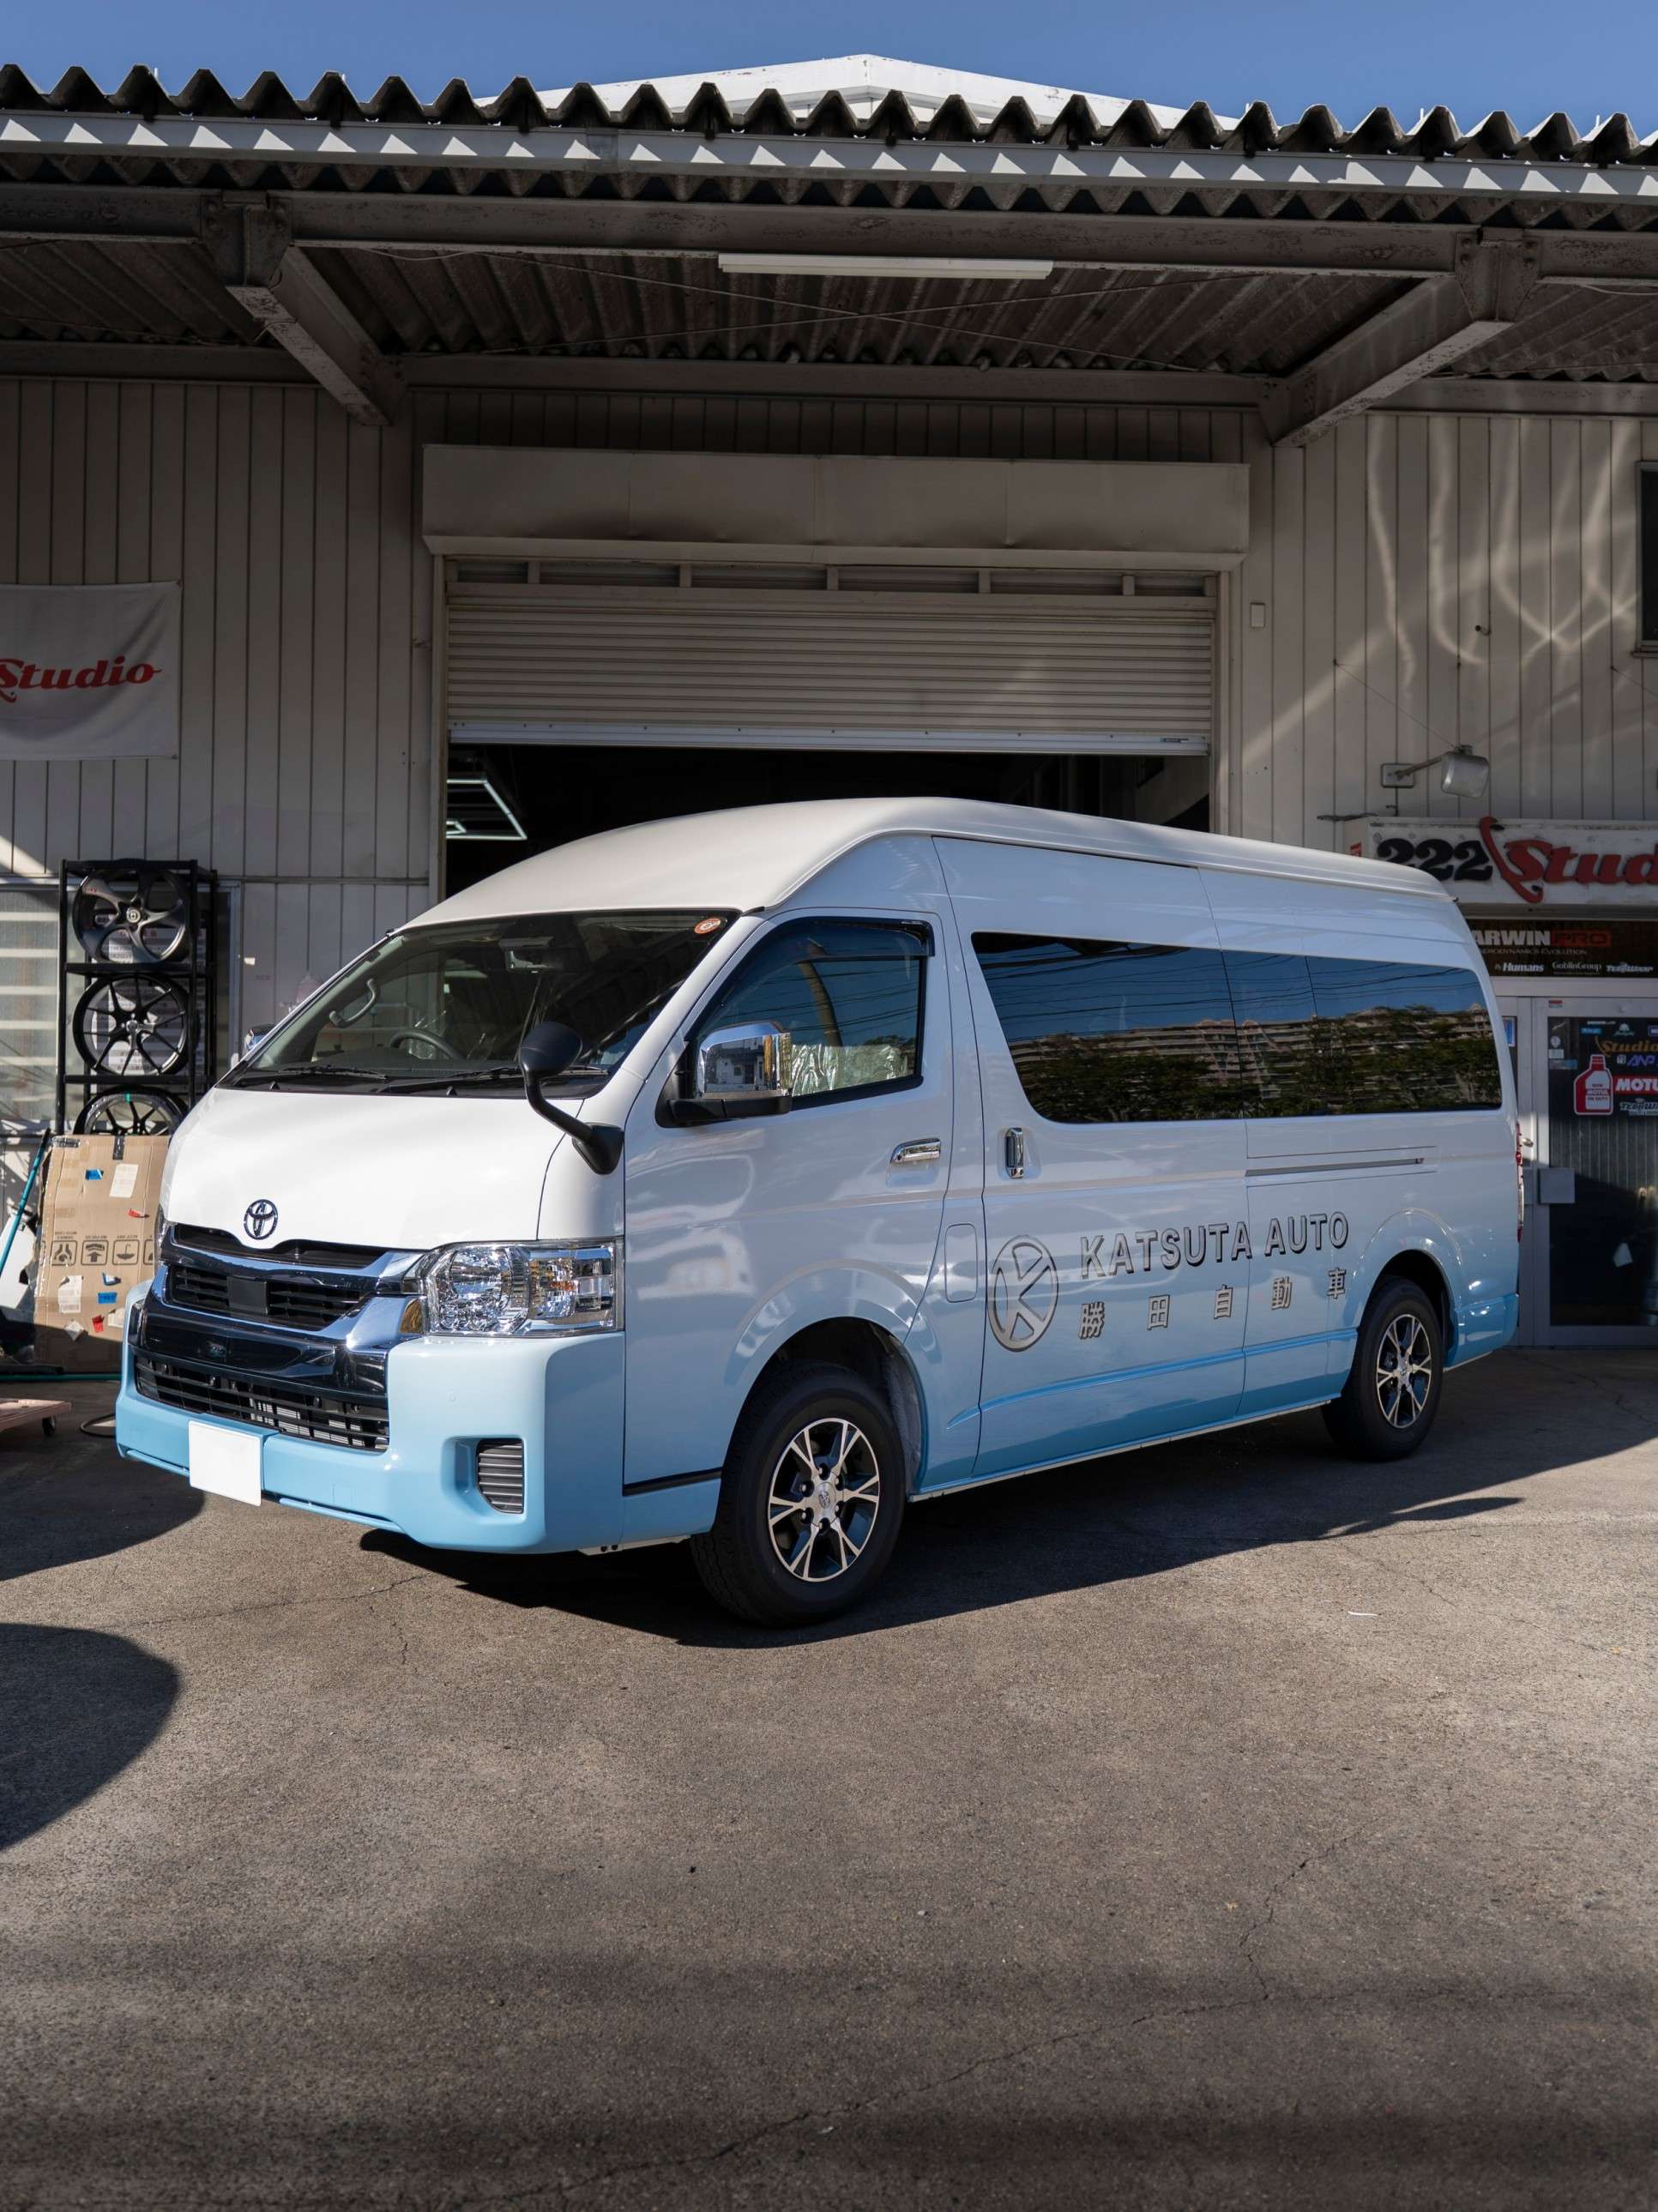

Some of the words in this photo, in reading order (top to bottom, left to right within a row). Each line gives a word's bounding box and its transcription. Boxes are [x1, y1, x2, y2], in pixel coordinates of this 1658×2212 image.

[0, 656, 162, 702] Studio
[1377, 838, 1493, 881] 222
[1503, 961, 1545, 973] Humans
[1081, 1221, 1251, 1279] KATSUTA
[1265, 1211, 1349, 1257] AUTO
